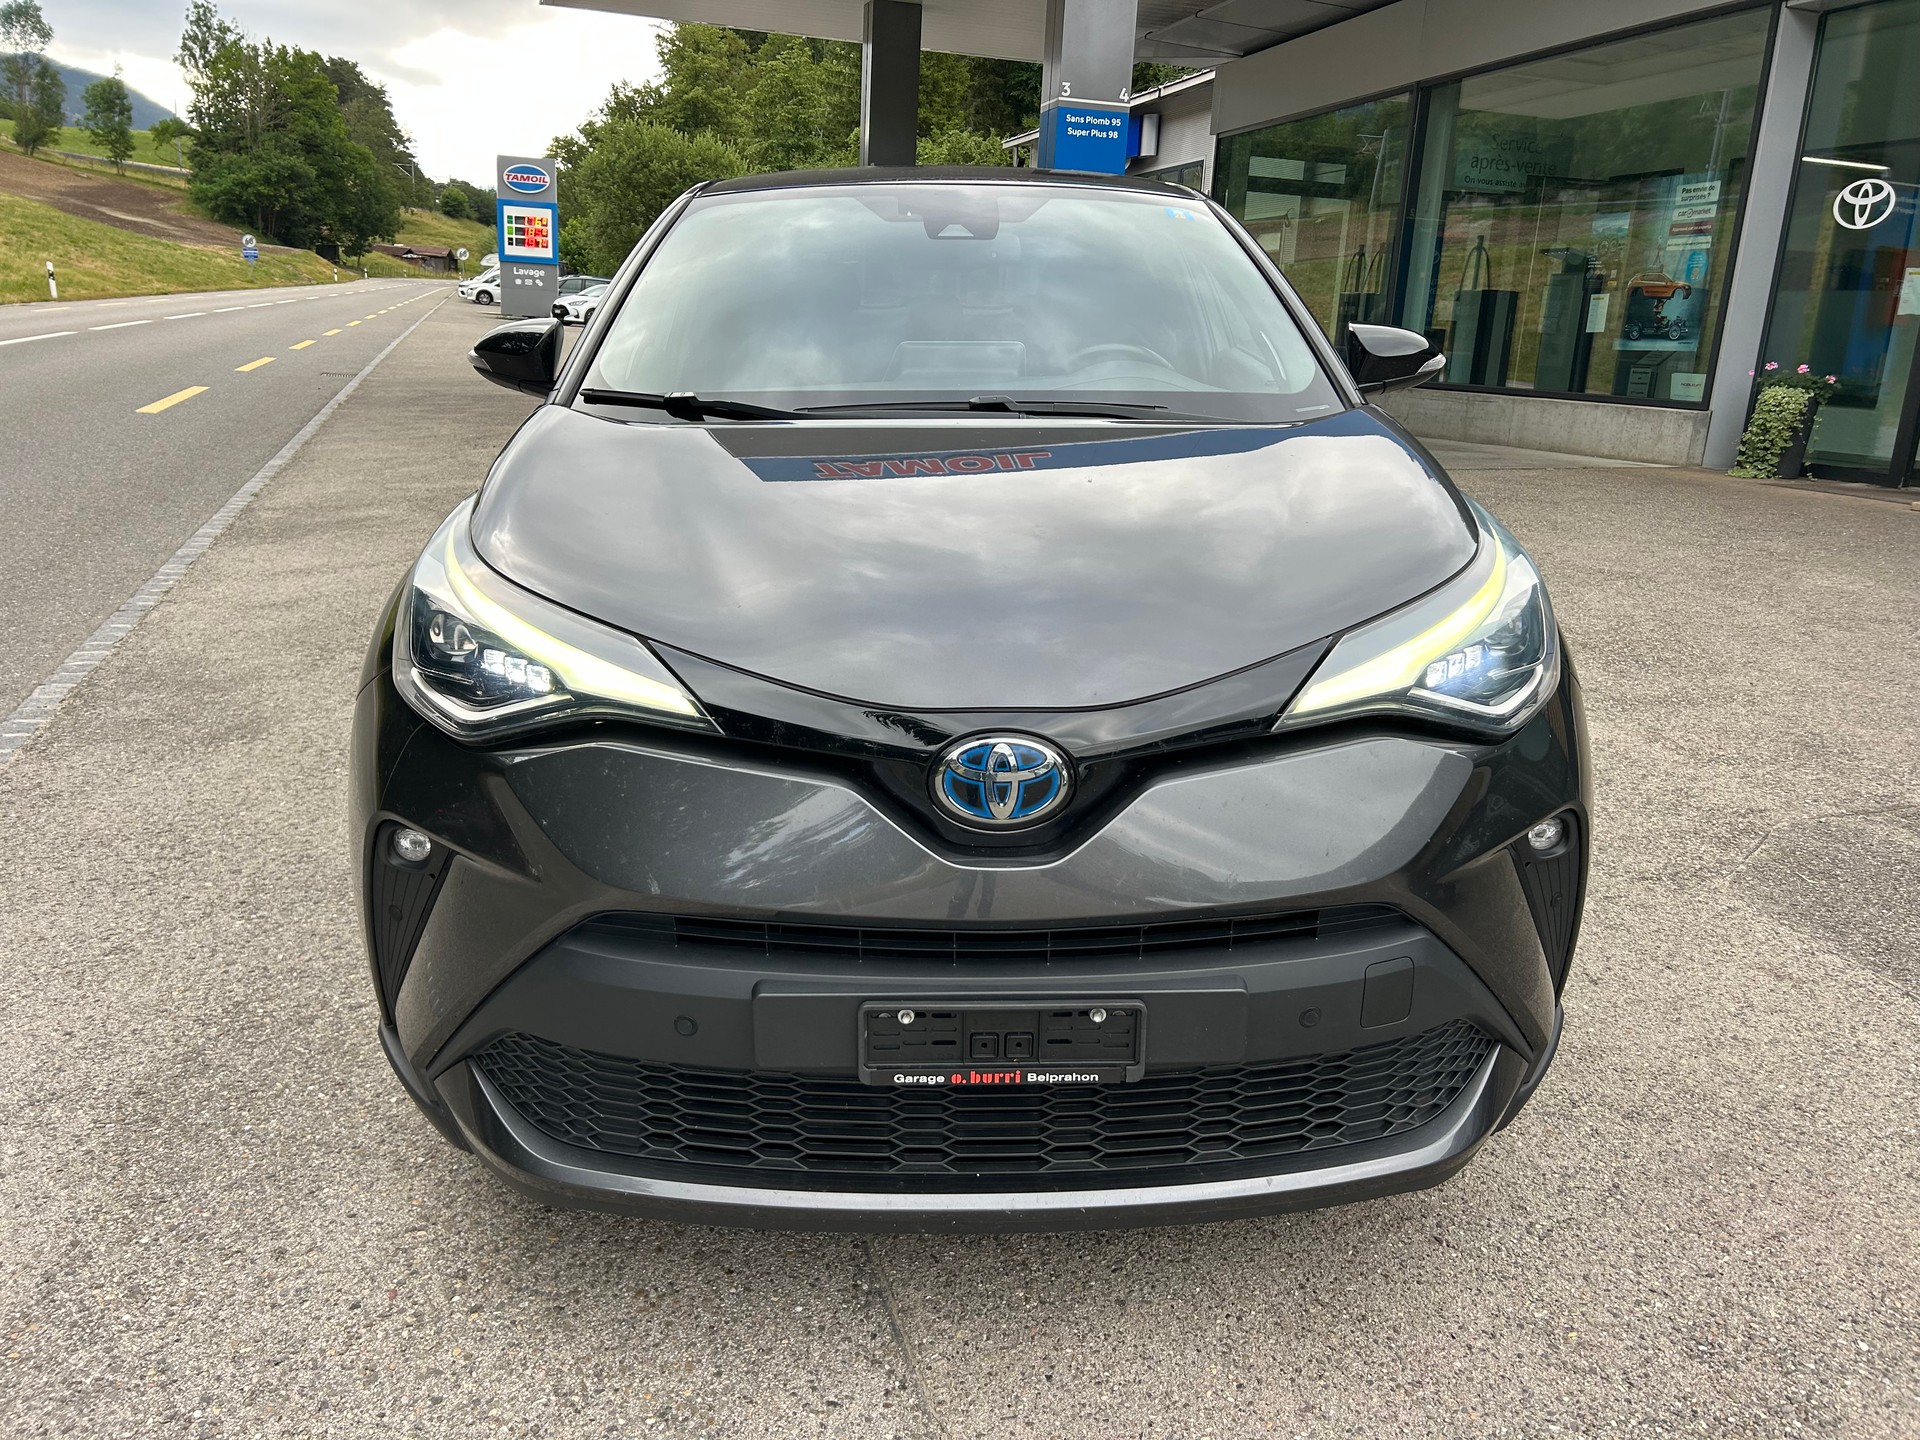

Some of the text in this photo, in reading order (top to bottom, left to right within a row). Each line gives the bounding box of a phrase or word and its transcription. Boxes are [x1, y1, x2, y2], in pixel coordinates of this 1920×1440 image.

[1061, 82, 1071, 96] 3
[1119, 88, 1129, 102] 4
[1066, 114, 1122, 127] Sans Plomb 95
[1067, 127, 1119, 139] Super Plus 98
[1491, 133, 1544, 154] Service
[1470, 154, 1557, 175] après-vente
[505, 174, 548, 184] TAMOIL
[1464, 175, 1475, 183] On
[1477, 178, 1494, 186] vous
[1680, 194, 1706, 202] surprises
[513, 266, 546, 277] Lavage
[893, 1073, 945, 1085] Garage
[1027, 1071, 1099, 1083] Belprahon
